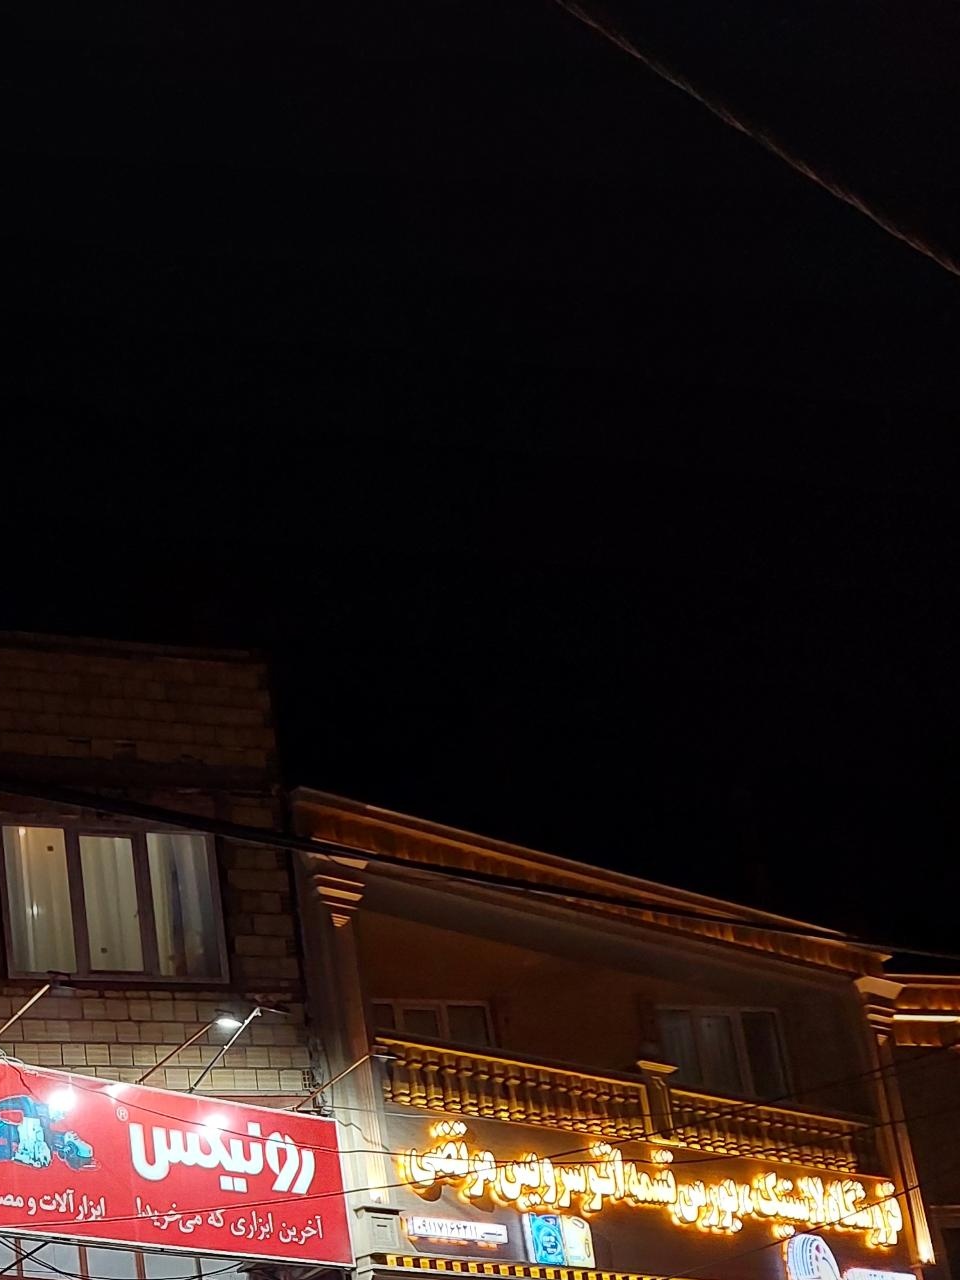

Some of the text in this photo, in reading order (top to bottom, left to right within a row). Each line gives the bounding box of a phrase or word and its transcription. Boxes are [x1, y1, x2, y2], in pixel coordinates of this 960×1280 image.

[129, 1121, 316, 1195] رونیکس
[27, 1195, 37, 1216] و
[207, 1208, 226, 1228] که
[231, 1211, 274, 1240] ابزاری
[279, 1216, 323, 1244] آخرین
